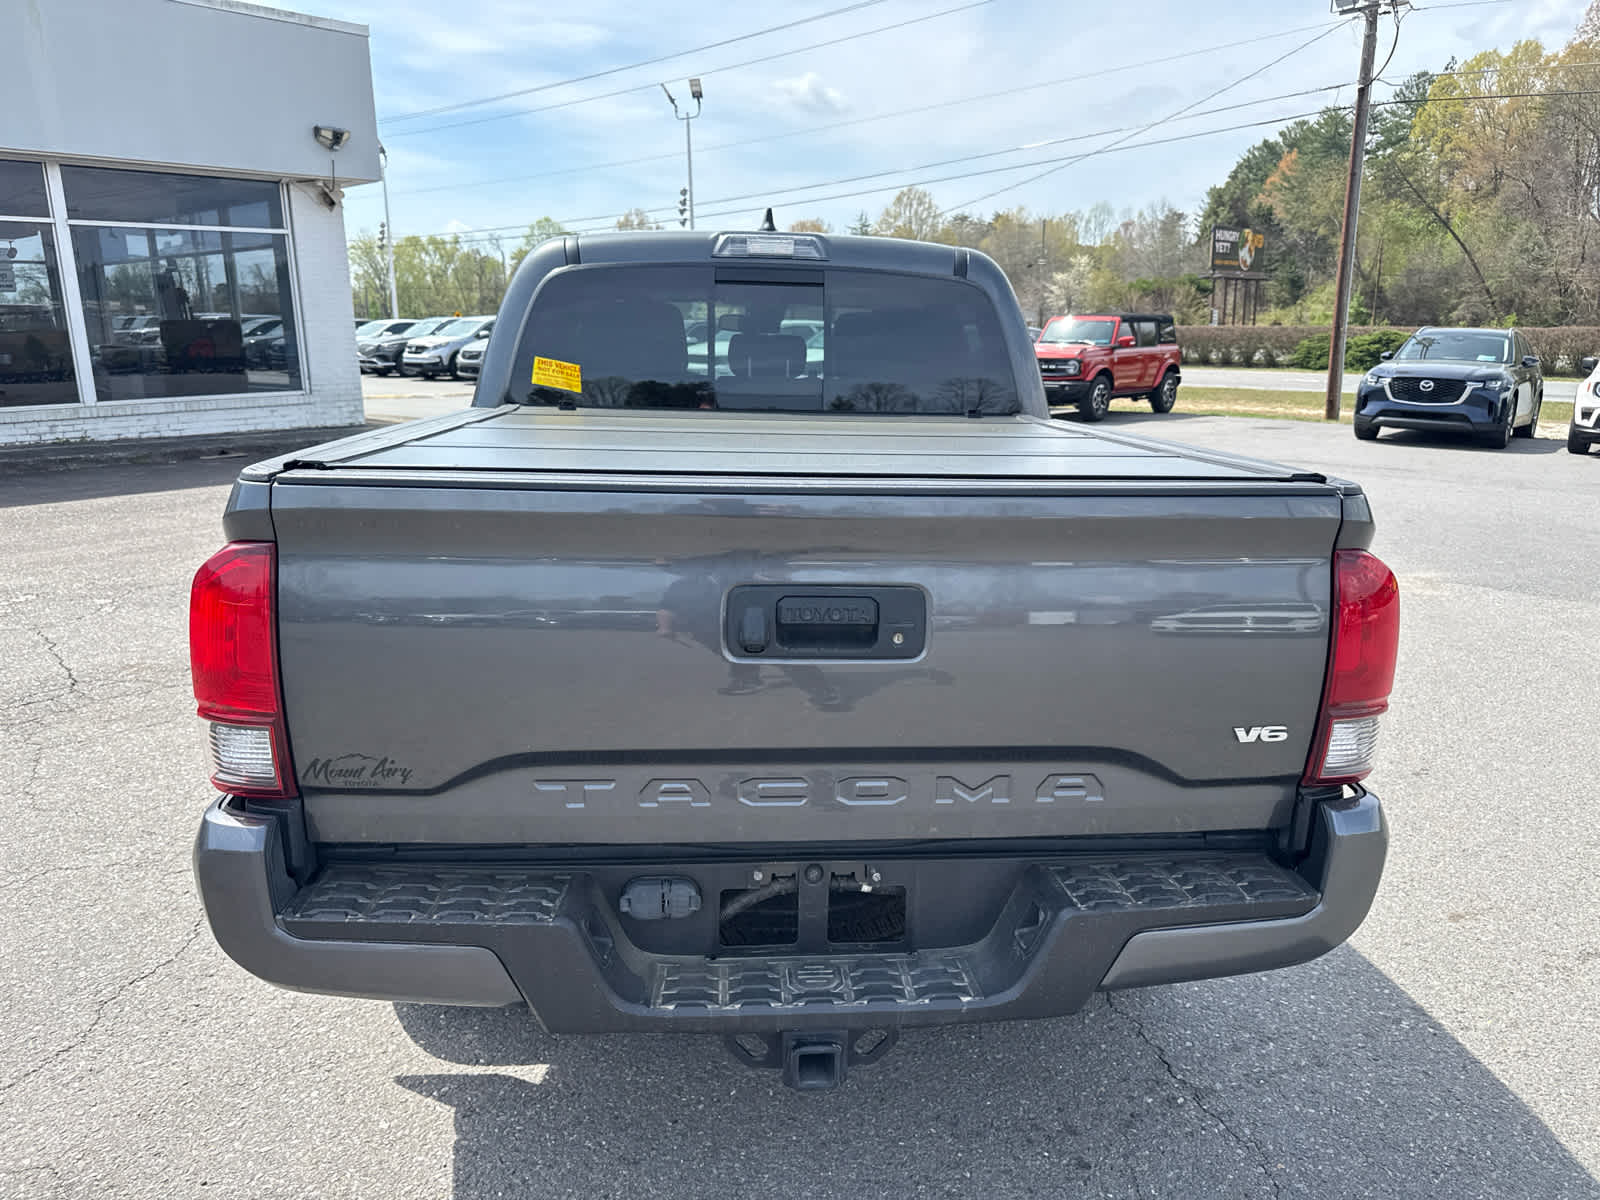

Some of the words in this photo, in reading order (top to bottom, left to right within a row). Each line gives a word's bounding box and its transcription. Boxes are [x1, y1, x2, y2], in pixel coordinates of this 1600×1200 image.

[783, 606, 873, 623] TOYOTA
[1233, 726, 1288, 743] V6
[302, 758, 367, 785] Mount
[370, 756, 414, 785] Airy
[533, 772, 1106, 808] TACOMA
